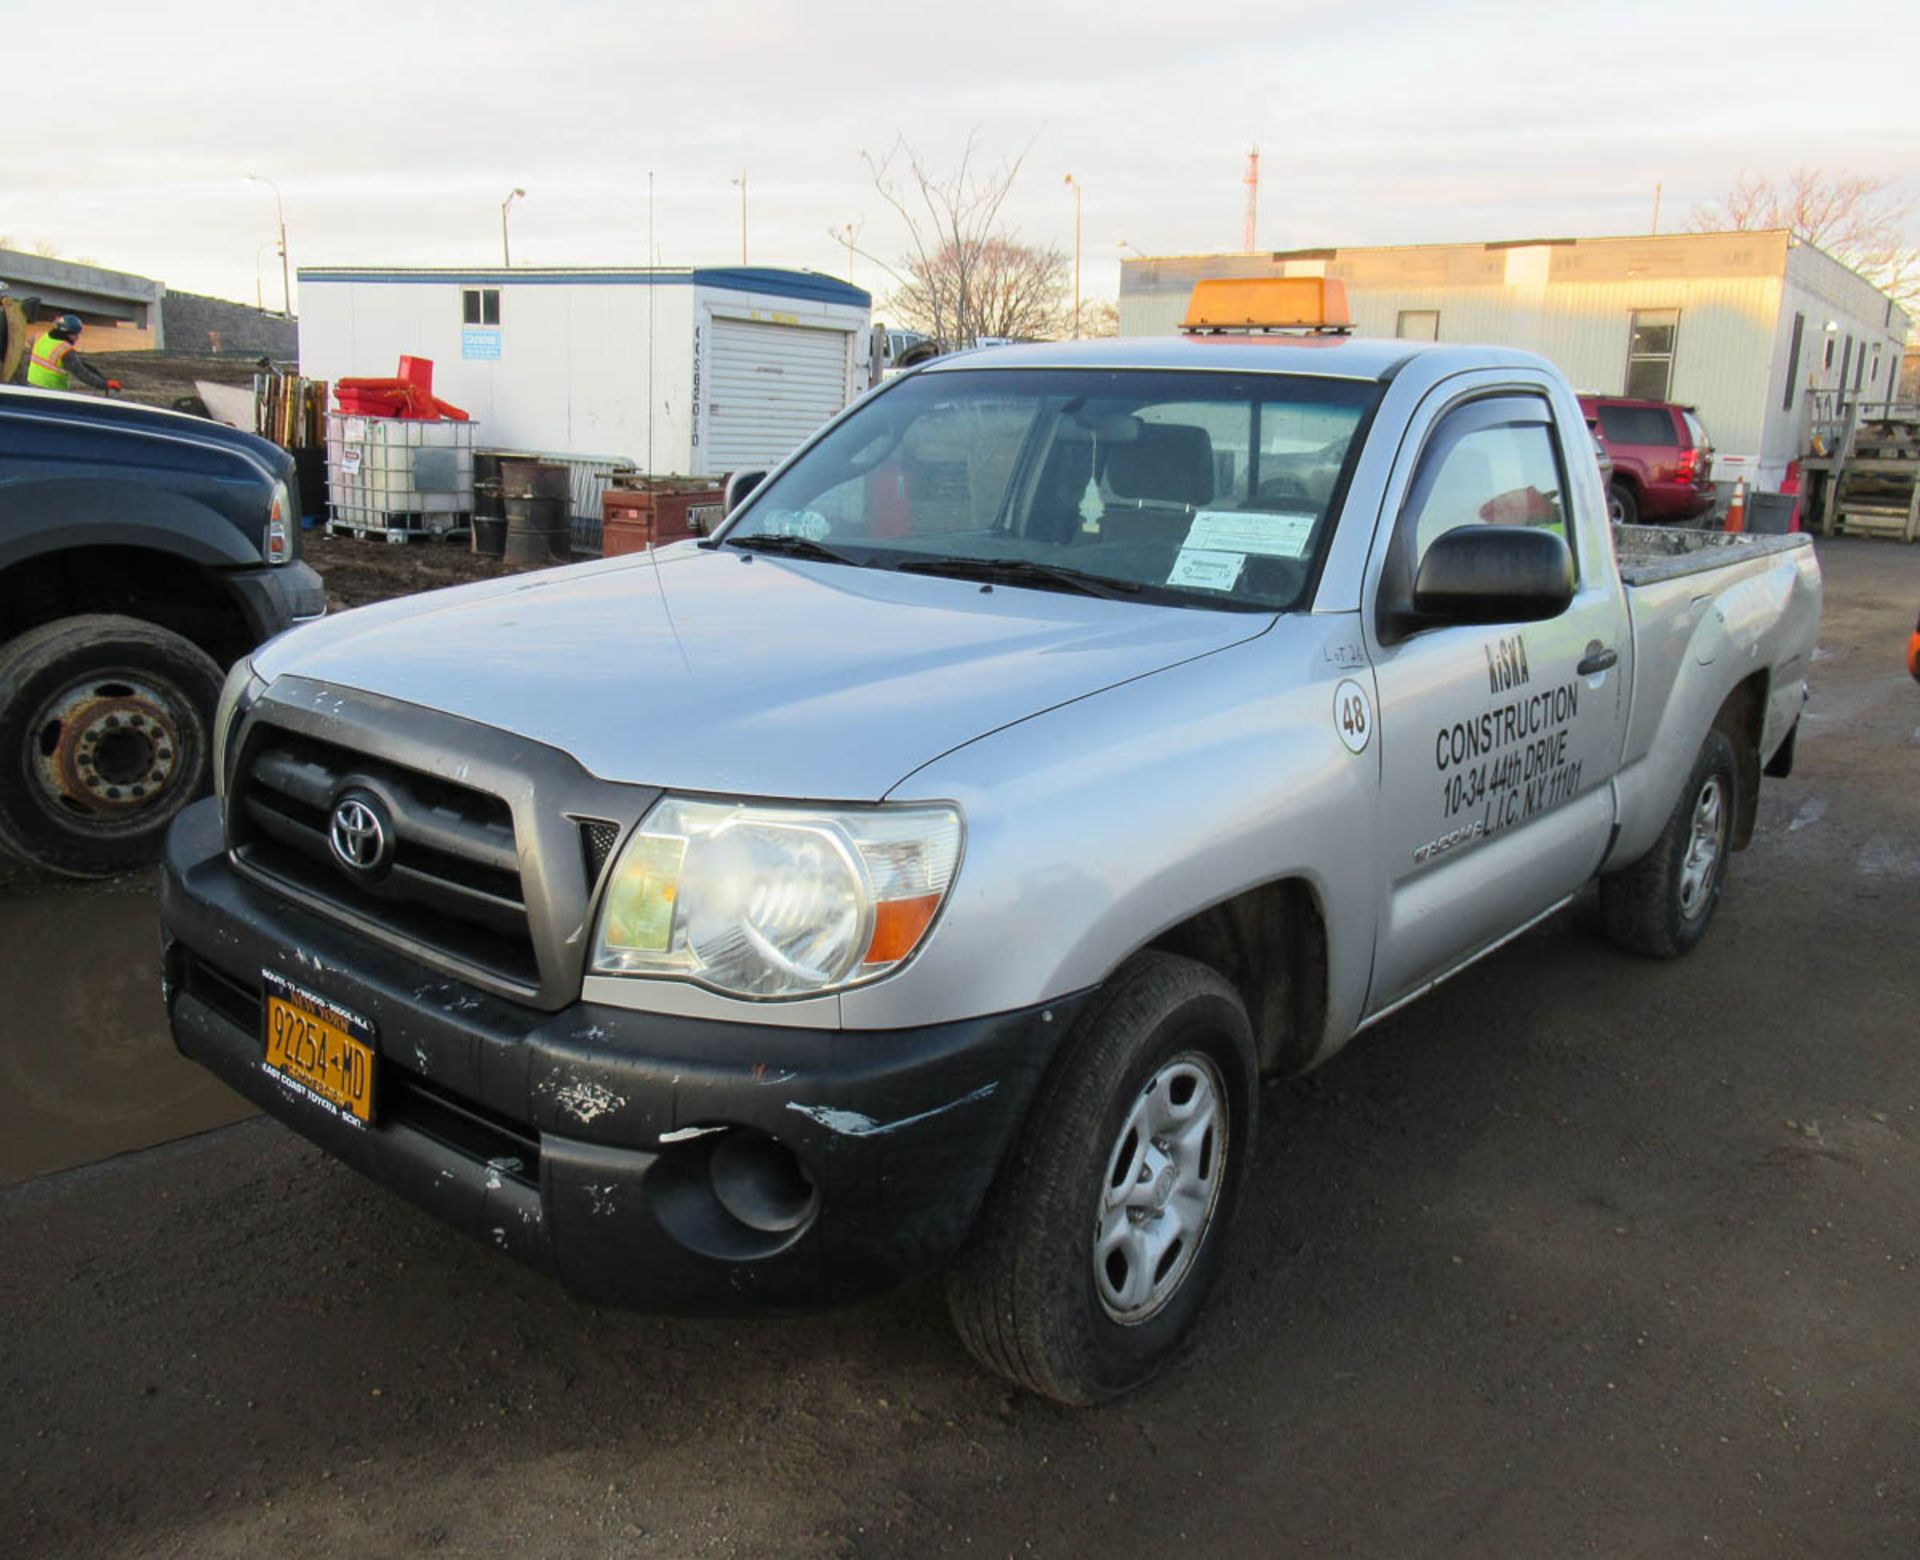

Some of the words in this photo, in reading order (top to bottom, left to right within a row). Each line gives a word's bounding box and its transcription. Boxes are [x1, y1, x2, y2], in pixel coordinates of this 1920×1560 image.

[1343, 695, 1366, 736] 48
[1436, 682, 1578, 771] CONSTRUCTION
[1444, 764, 1487, 818] 10-34
[1489, 751, 1522, 796] 44th
[1524, 729, 1569, 781] DRIVE
[1549, 758, 1583, 806] 11101
